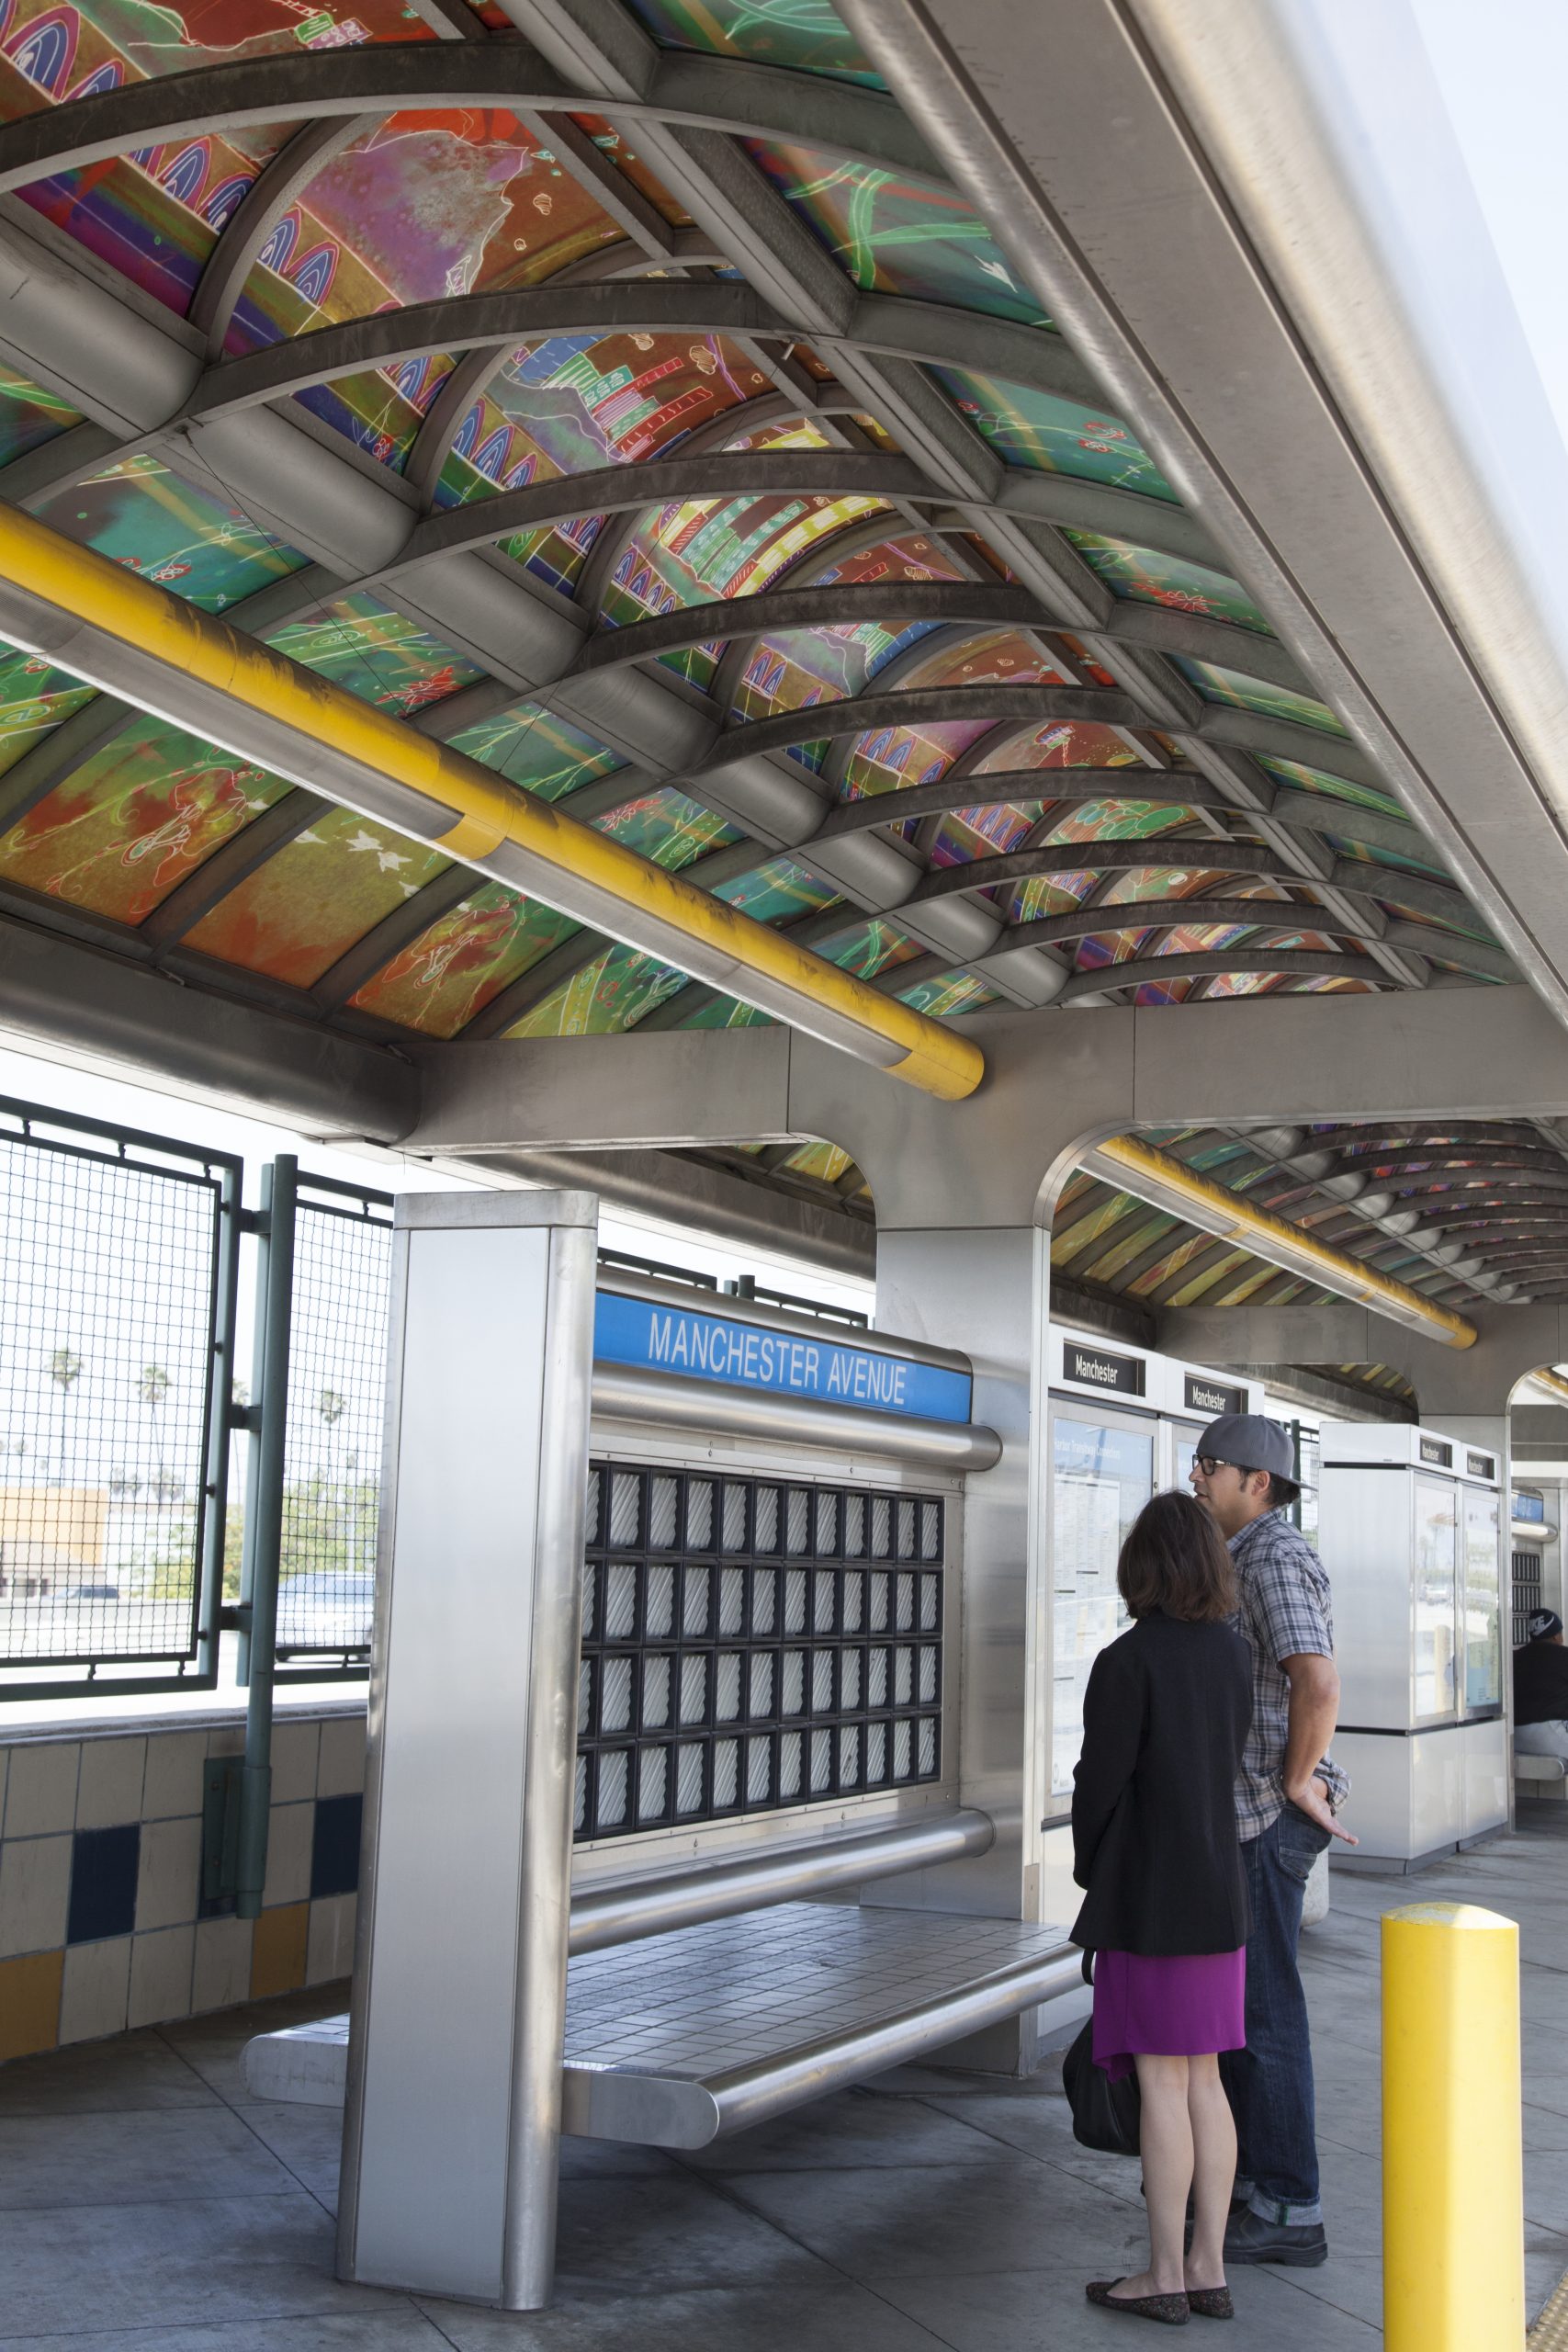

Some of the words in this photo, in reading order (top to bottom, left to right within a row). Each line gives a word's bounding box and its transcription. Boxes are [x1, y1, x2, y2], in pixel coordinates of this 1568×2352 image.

[649, 1312, 819, 1390] MANCHESTER
[827, 1351, 906, 1406] AVENUE
[1076, 1353, 1118, 1385] Manchester
[1192, 1385, 1226, 1412] Manchester
